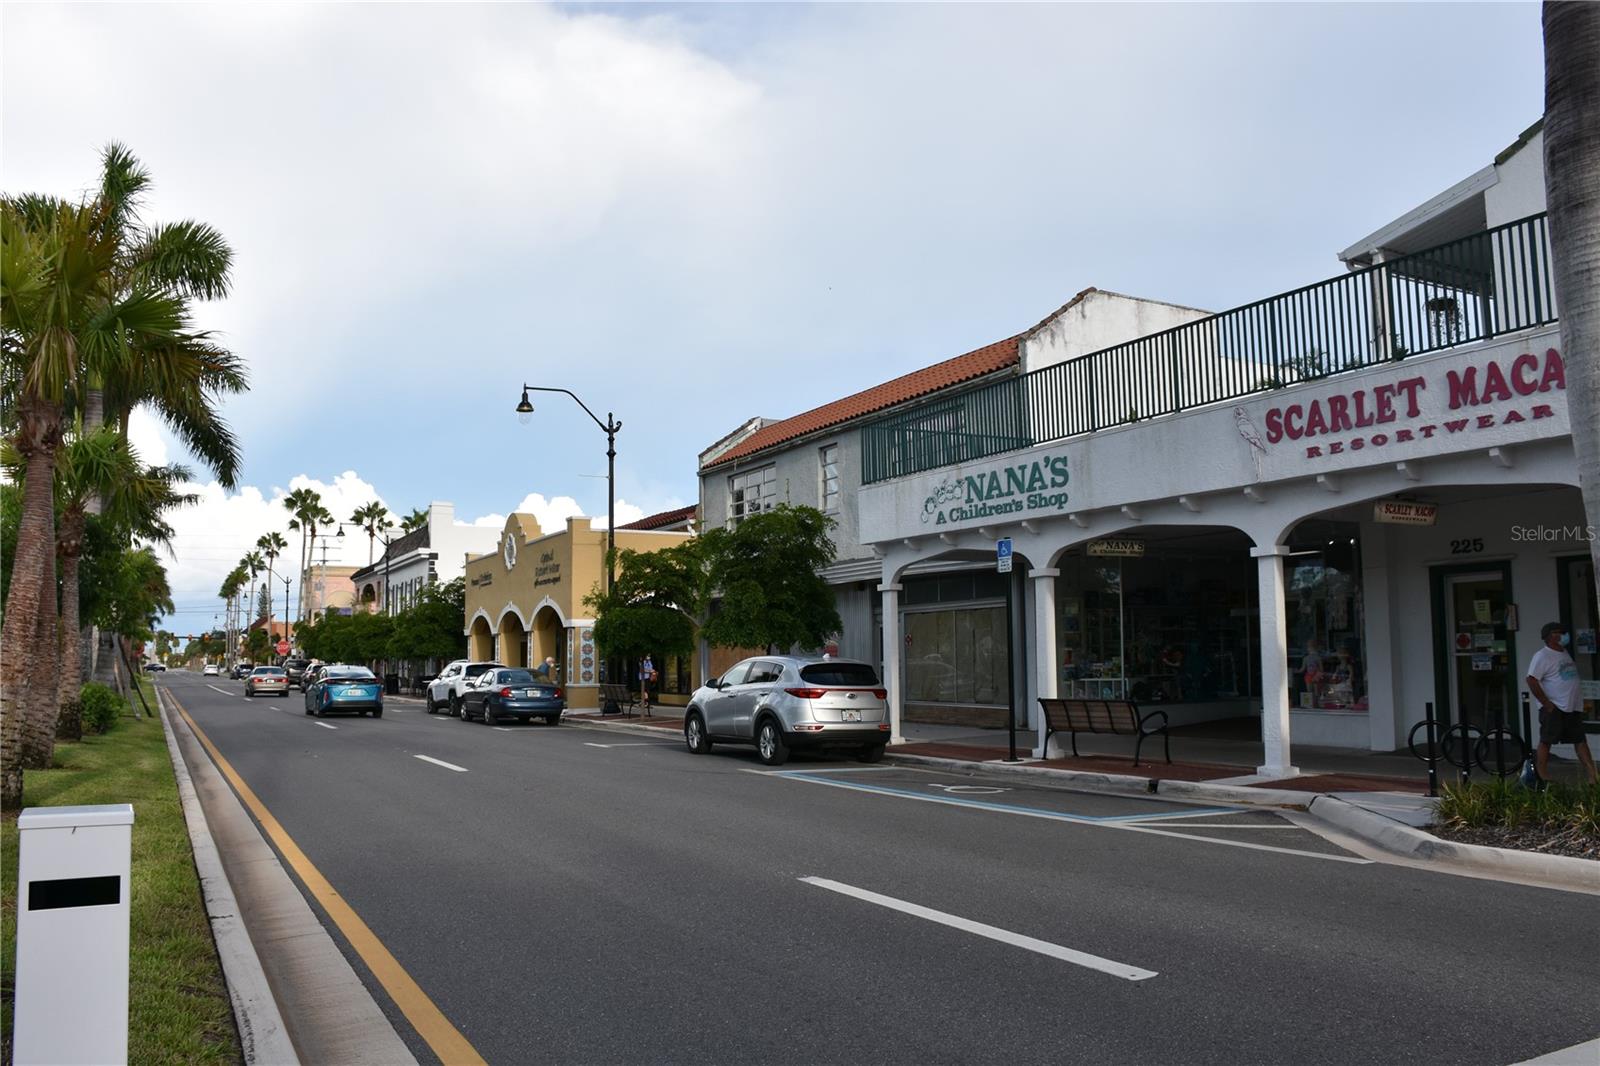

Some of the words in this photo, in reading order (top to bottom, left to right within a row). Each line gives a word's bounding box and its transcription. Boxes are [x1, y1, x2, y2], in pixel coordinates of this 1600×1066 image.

[1265, 376, 1426, 444] SCARLET
[1446, 347, 1566, 410] MACA
[1306, 404, 1555, 459] RESORTWEAR
[965, 455, 1070, 504] NANA'S
[936, 510, 948, 525] A
[949, 499, 1024, 522] Children's
[1027, 492, 1069, 510] Shop
[1450, 538, 1485, 554] 225
